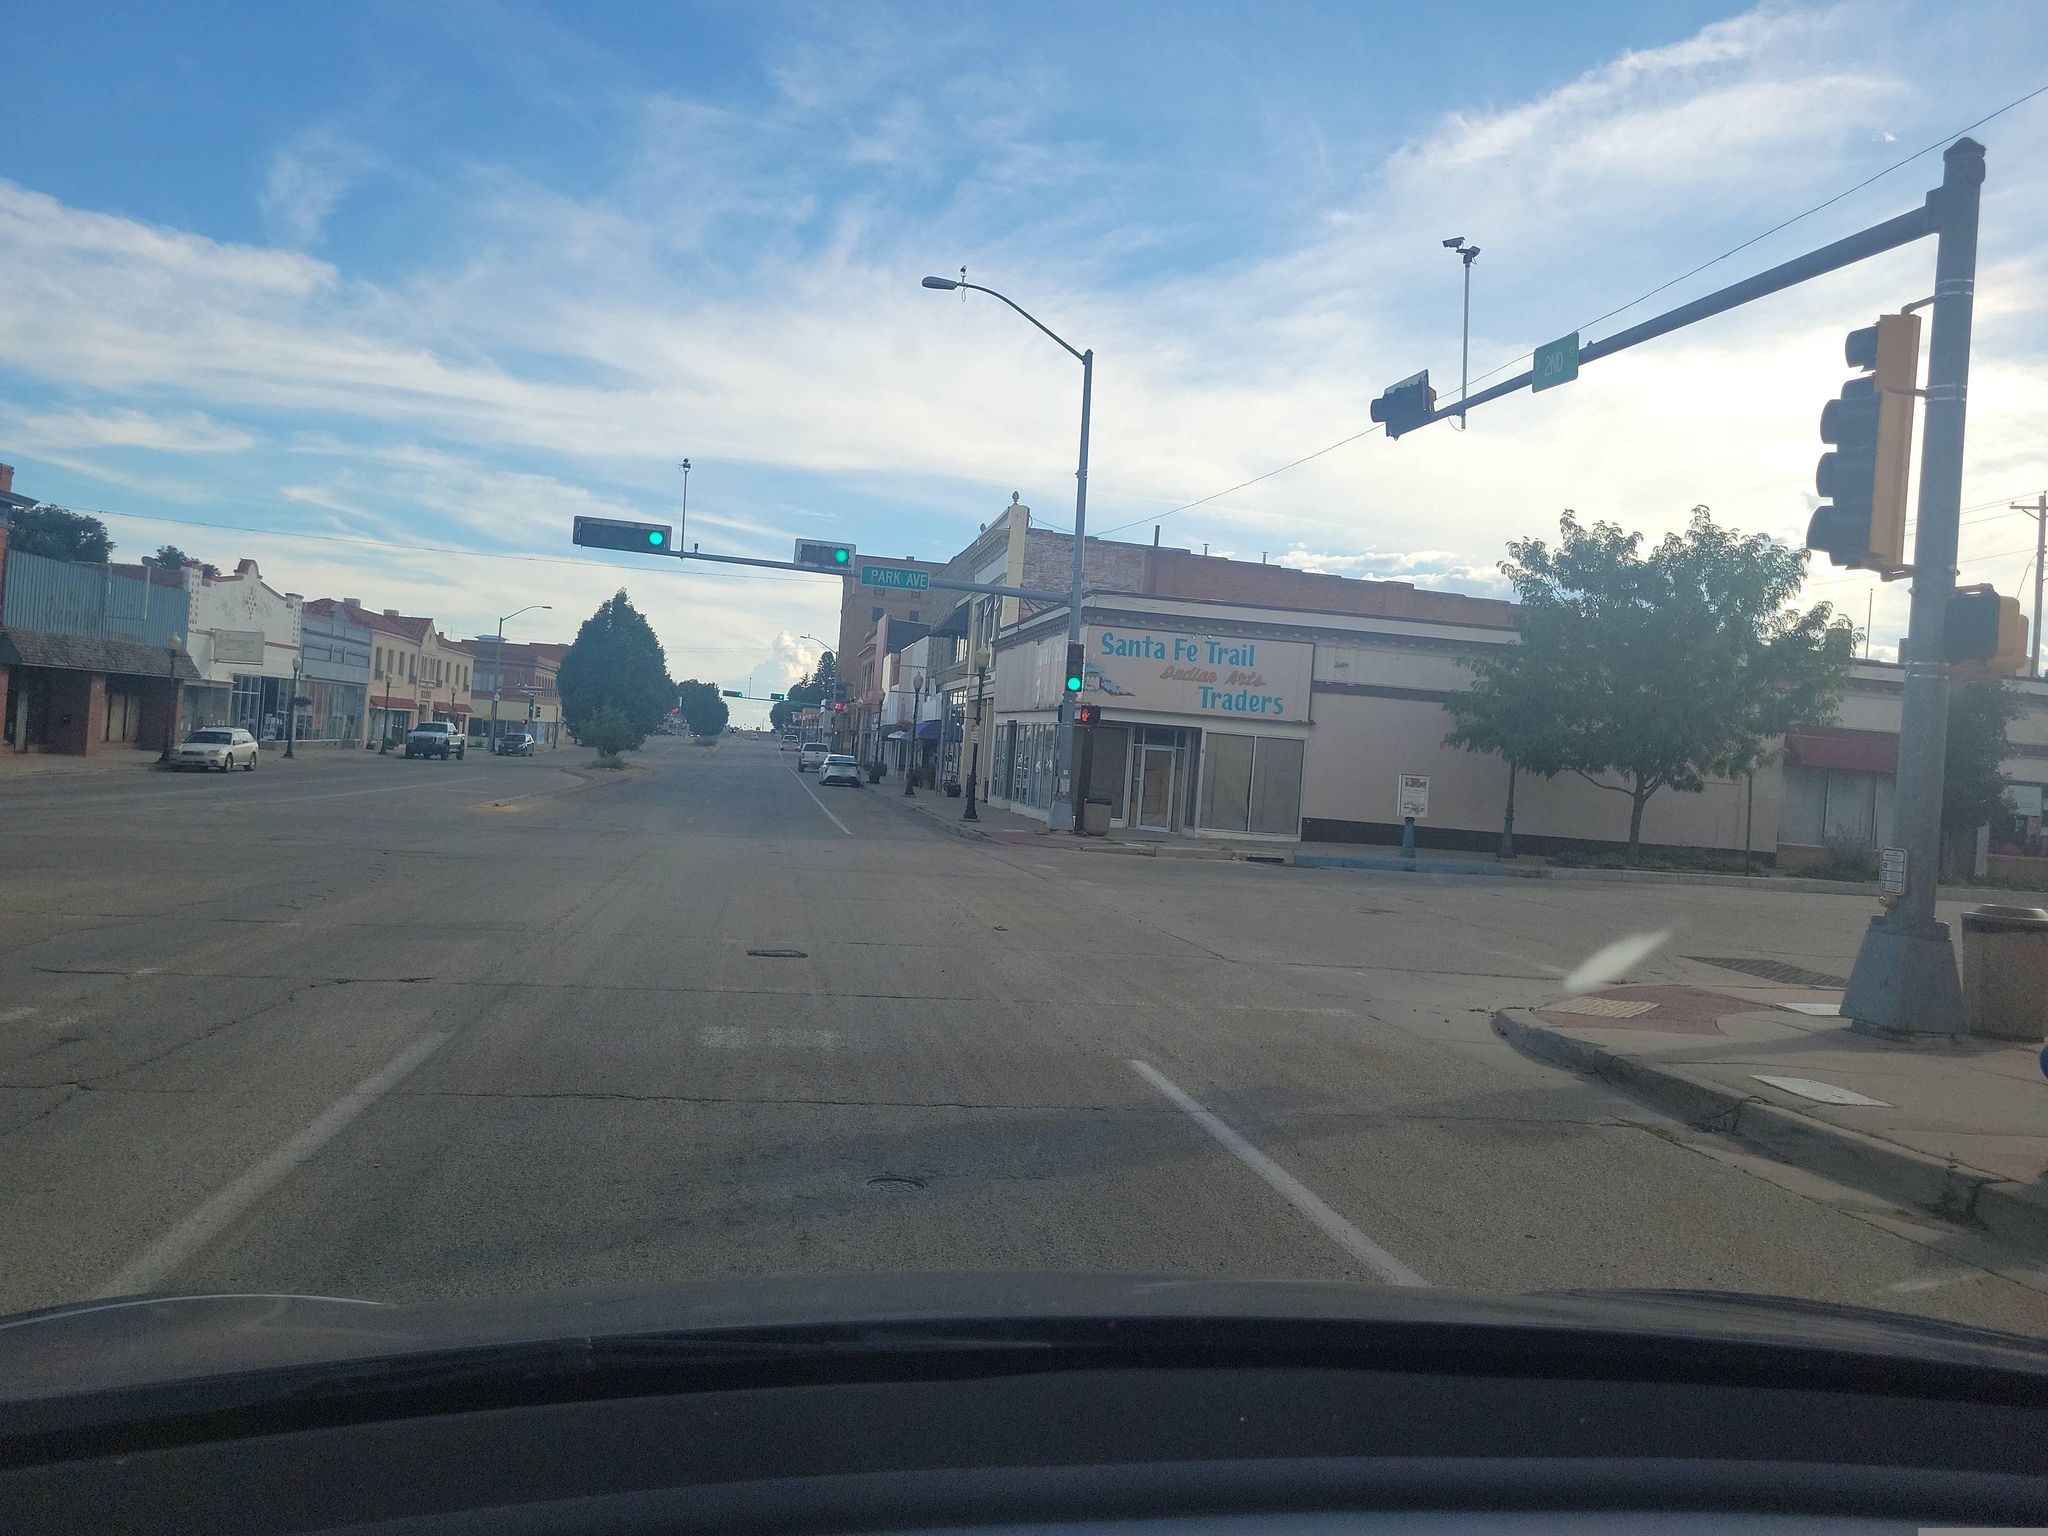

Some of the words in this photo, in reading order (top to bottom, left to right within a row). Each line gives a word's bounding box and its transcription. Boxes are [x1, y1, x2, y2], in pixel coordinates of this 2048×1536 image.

[1544, 351, 1564, 377] 2ND
[871, 570, 901, 584] PARK
[906, 574, 927, 587] AVE
[1101, 632, 1166, 660] Santa
[1173, 638, 1198, 663] Fe
[1204, 640, 1256, 667] Trail
[1160, 665, 1218, 683] Indian
[1198, 685, 1284, 715] Traders
